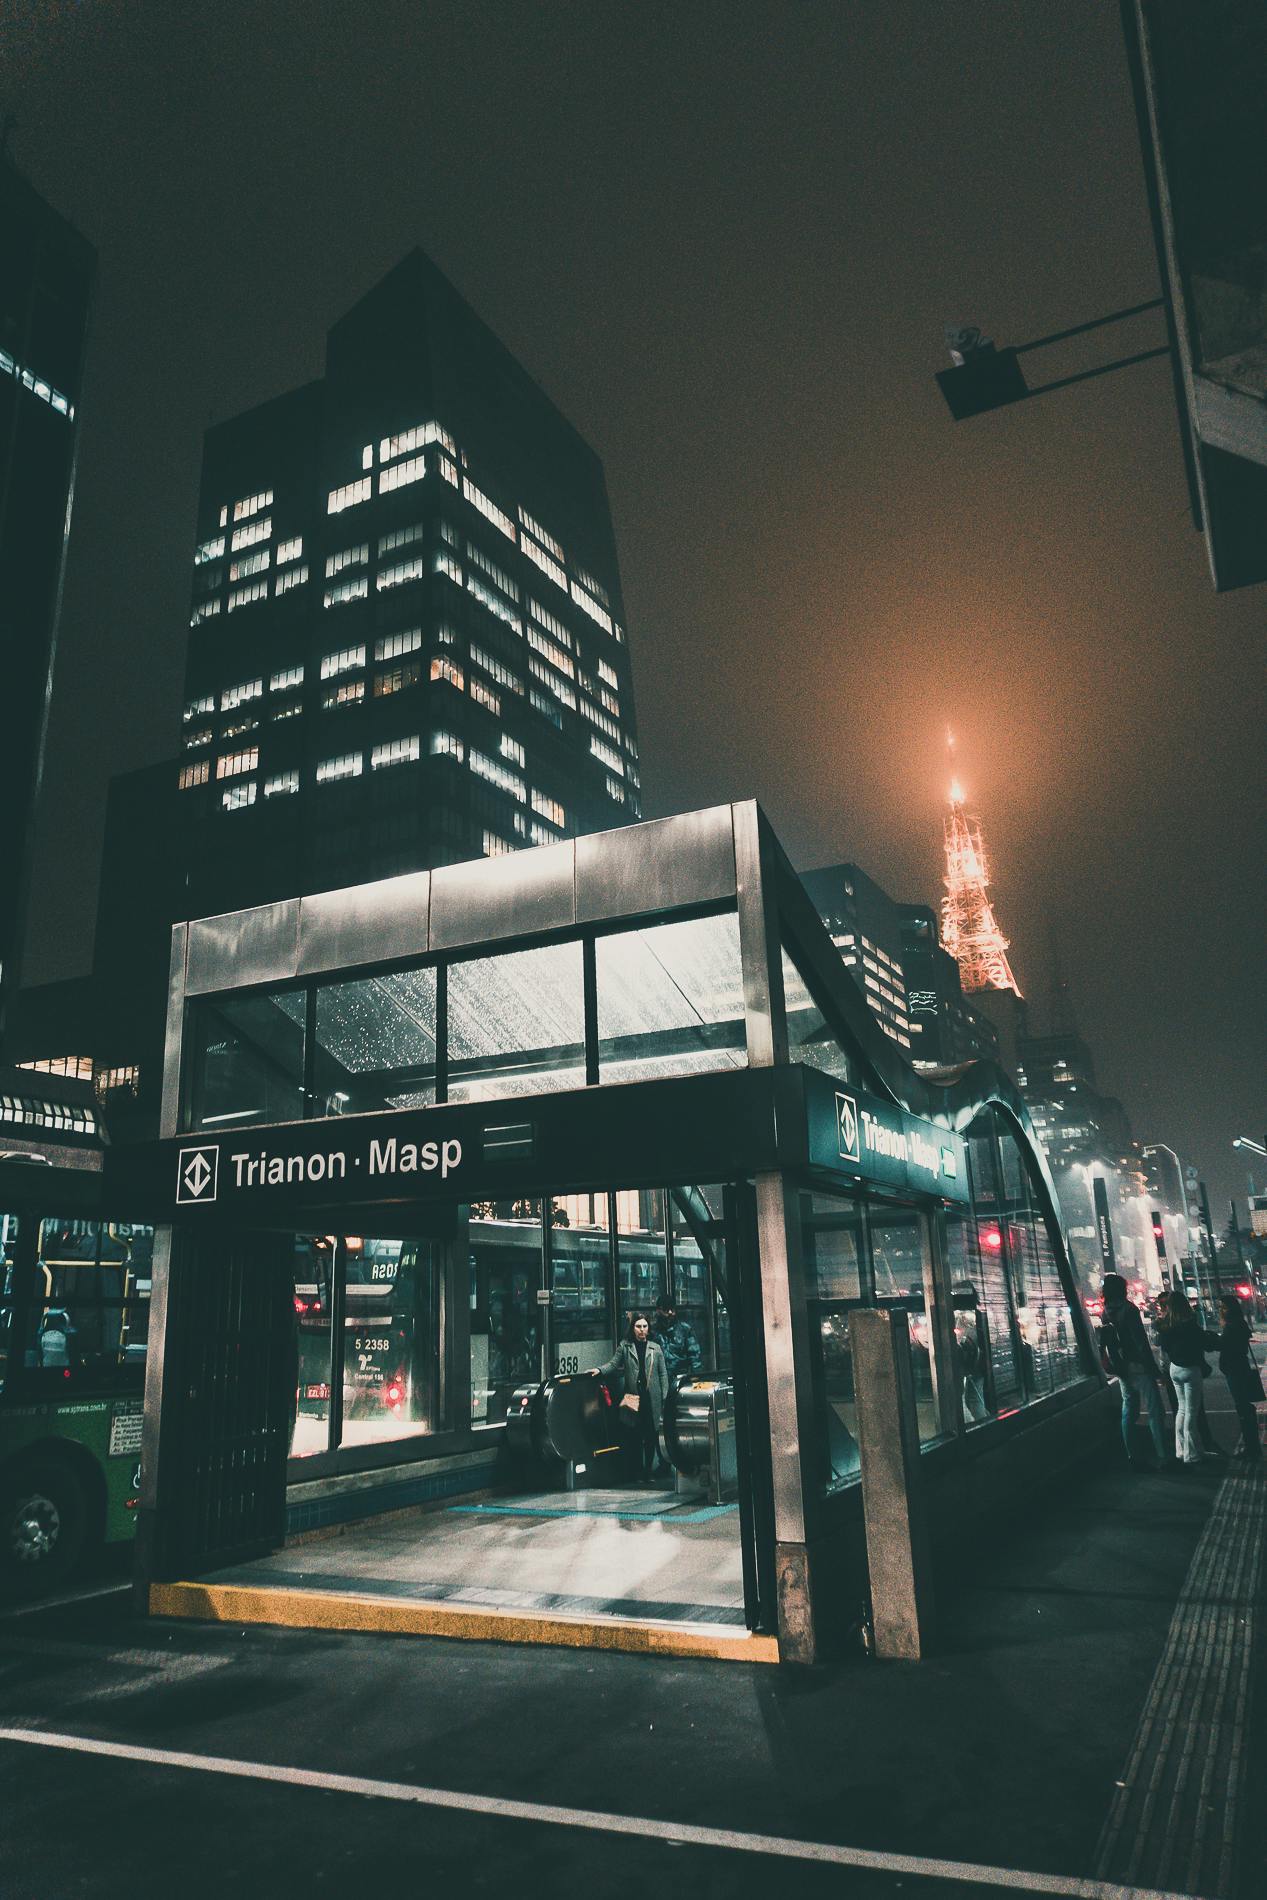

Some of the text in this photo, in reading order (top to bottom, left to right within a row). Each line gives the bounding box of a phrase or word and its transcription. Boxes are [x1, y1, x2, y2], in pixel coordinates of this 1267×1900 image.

[860, 1110, 909, 1162] Trianon
[231, 1151, 346, 1187] Trianon
[368, 1137, 462, 1179] Masp
[355, 1338, 390, 1351] 5 2358
